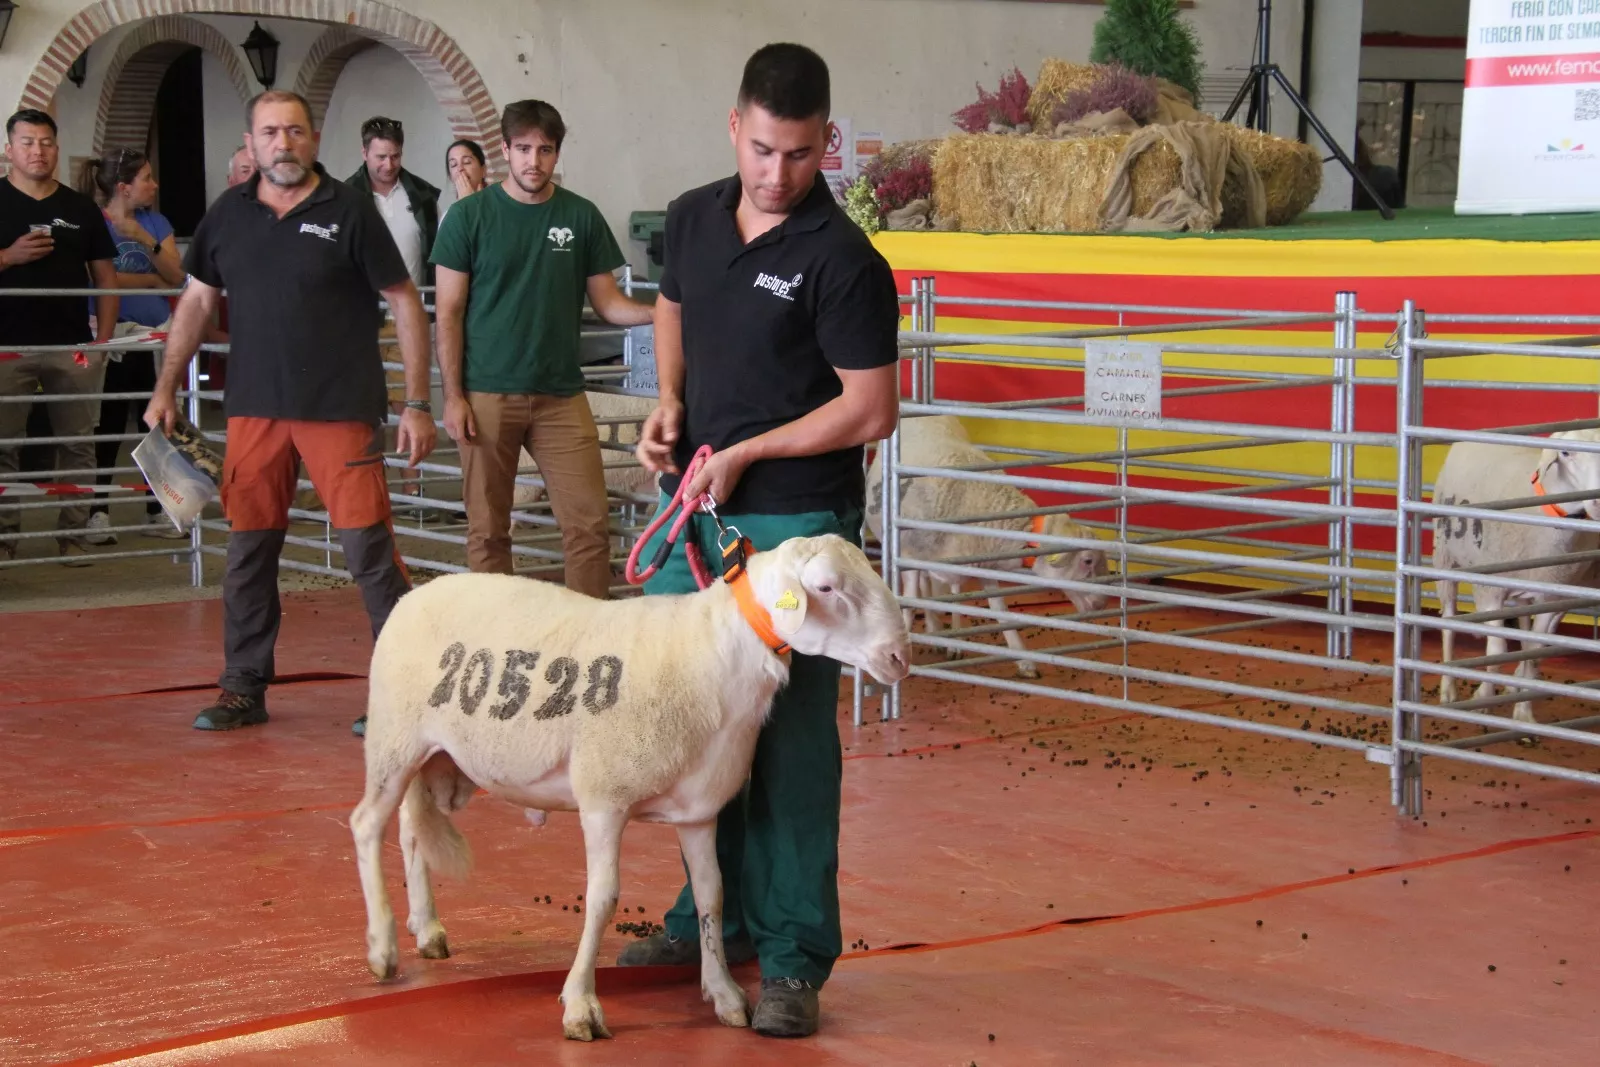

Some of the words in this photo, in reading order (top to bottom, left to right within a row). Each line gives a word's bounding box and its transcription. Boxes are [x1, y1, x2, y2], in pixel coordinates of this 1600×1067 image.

[1511, 1, 1544, 18] FERIA
[1548, 0, 1573, 16] CON
[1479, 26, 1522, 44] TERCER
[1526, 24, 1544, 42] FIN
[1549, 23, 1563, 41] DE
[753, 272, 792, 295] pastores
[1100, 391, 1146, 404] CARNES
[1086, 407, 1160, 420] OVIARAGON
[427, 641, 624, 721] 20528
